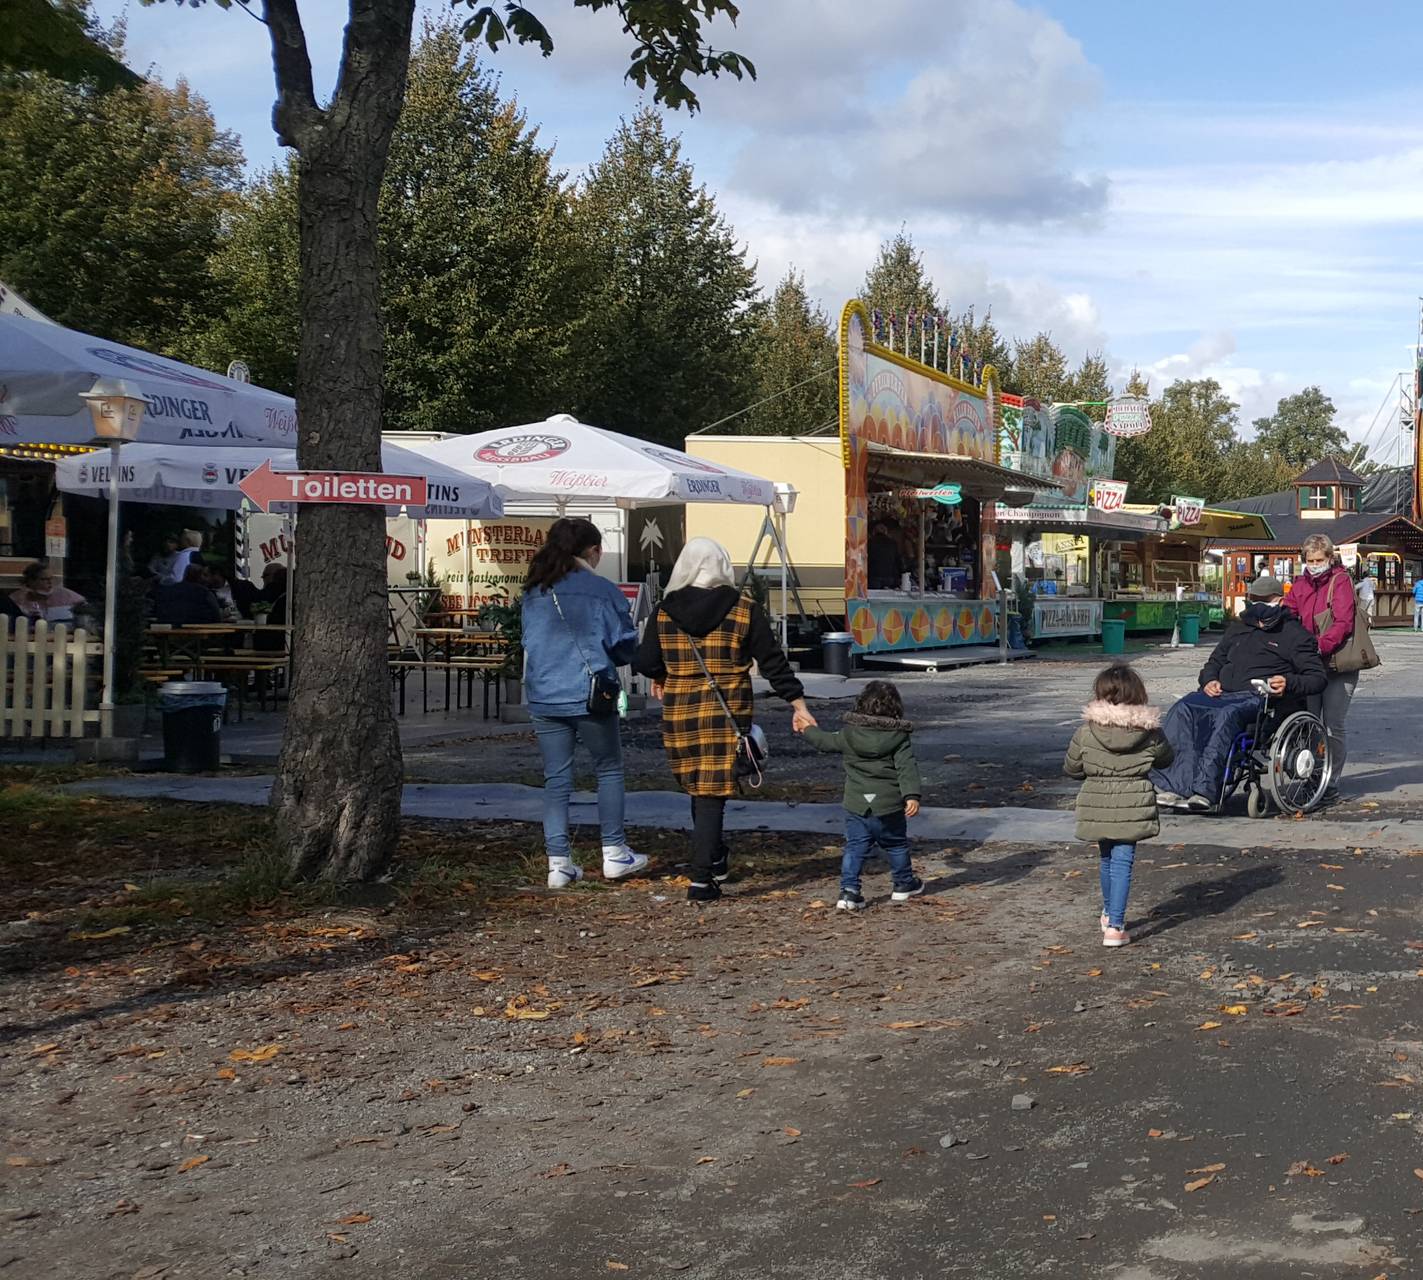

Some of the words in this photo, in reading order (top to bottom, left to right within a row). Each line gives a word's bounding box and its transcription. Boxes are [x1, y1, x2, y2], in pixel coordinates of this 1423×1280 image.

[143, 393, 213, 424] RDINGER
[91, 465, 135, 483] VELINS
[550, 470, 608, 490] Weißbier
[286, 476, 412, 501] Toiletten
[427, 483, 460, 502] TINS
[686, 478, 722, 495] ERDINGER
[1095, 489, 1124, 511] PIZZA
[1007, 509, 1061, 521] Champignon
[1178, 507, 1201, 523] PIZZA
[446, 525, 548, 556] MNSTERLA
